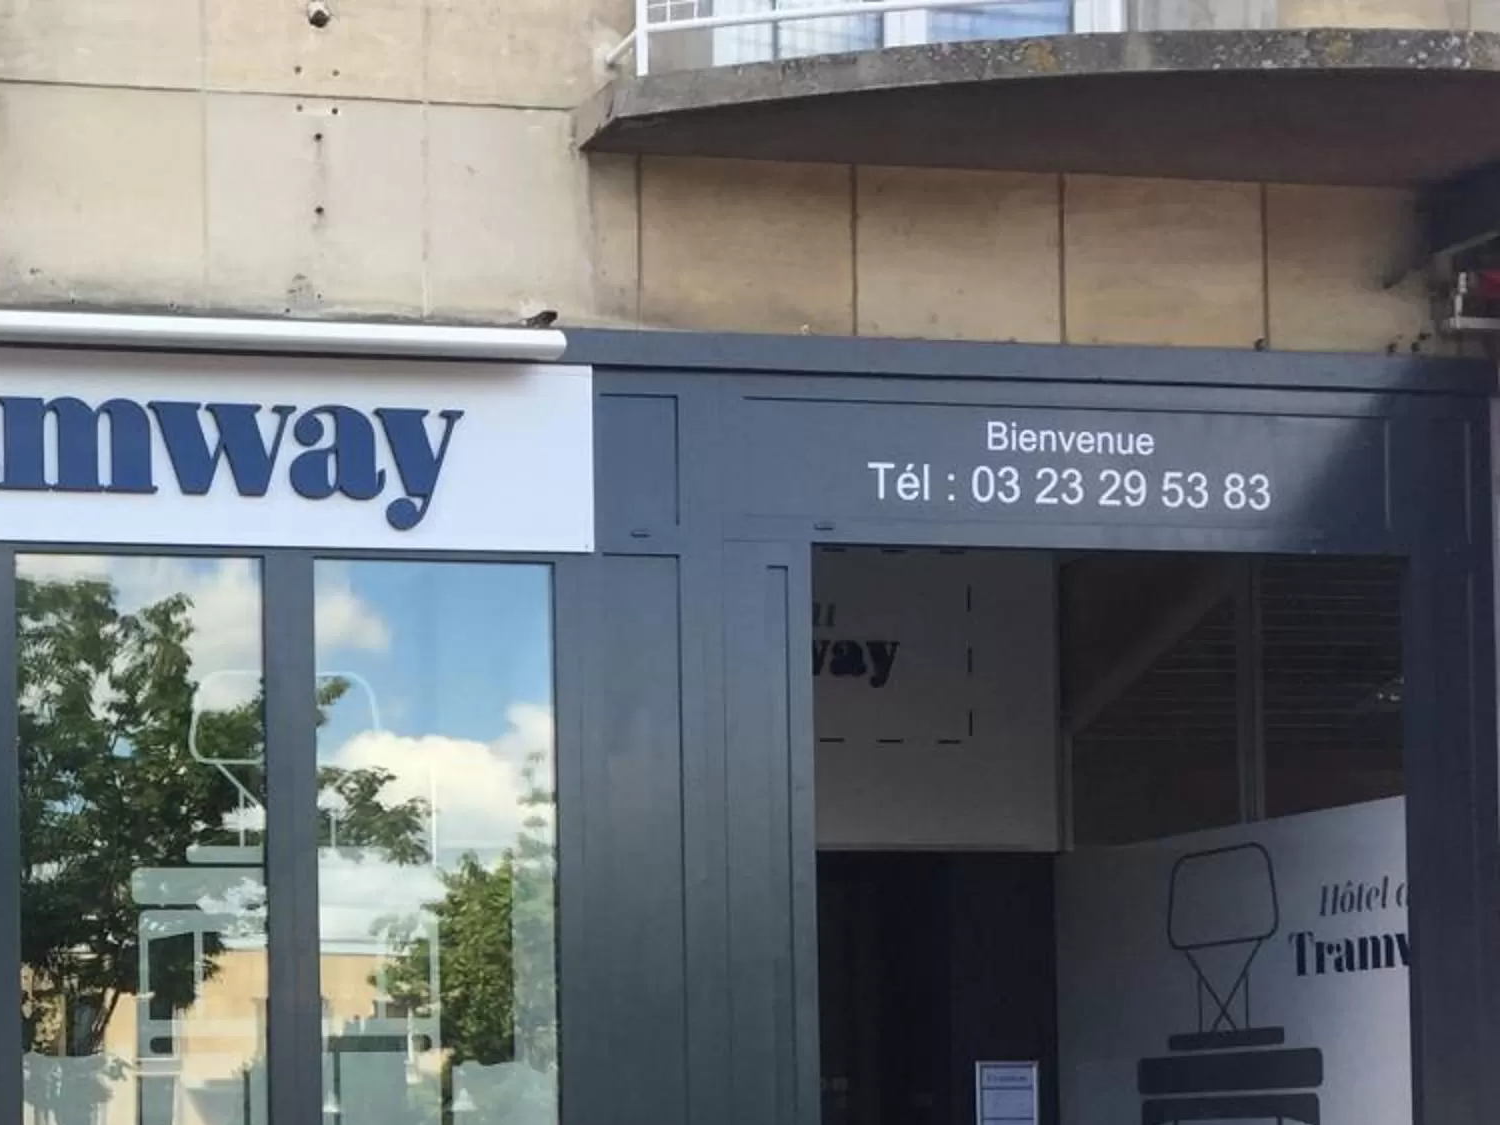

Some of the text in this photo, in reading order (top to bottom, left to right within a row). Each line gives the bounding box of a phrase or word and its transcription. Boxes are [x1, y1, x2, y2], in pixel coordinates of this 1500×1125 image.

[987, 421, 1155, 455] Bienvenue
[868, 462, 930, 501] Tél
[971, 466, 1021, 503] 03
[1035, 467, 1084, 505] 23
[1099, 469, 1147, 507] 29
[1161, 471, 1209, 509] 53
[1223, 473, 1271, 510] 83
[1319, 875, 1389, 917] Hôtel
